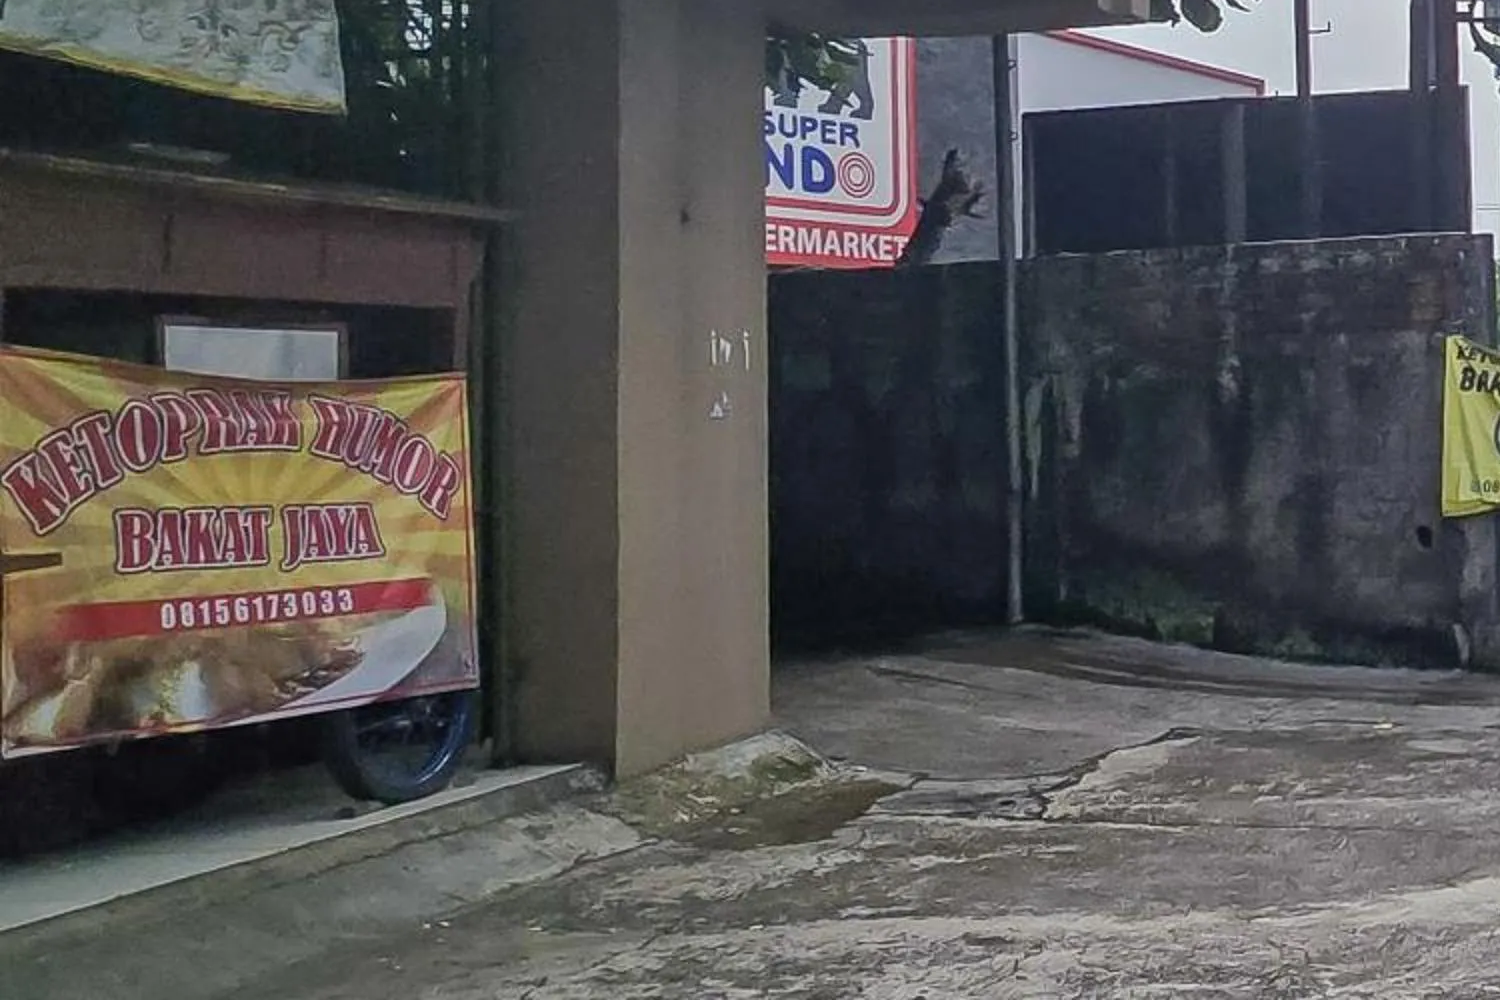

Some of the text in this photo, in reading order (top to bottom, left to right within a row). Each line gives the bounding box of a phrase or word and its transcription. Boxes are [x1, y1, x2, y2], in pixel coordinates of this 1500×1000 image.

[766, 111, 861, 148] SUPER
[2, 389, 462, 536] KETOPRAK HUMOR
[113, 502, 386, 574] BAKAT JAYA
[161, 588, 354, 630] 08156173033
